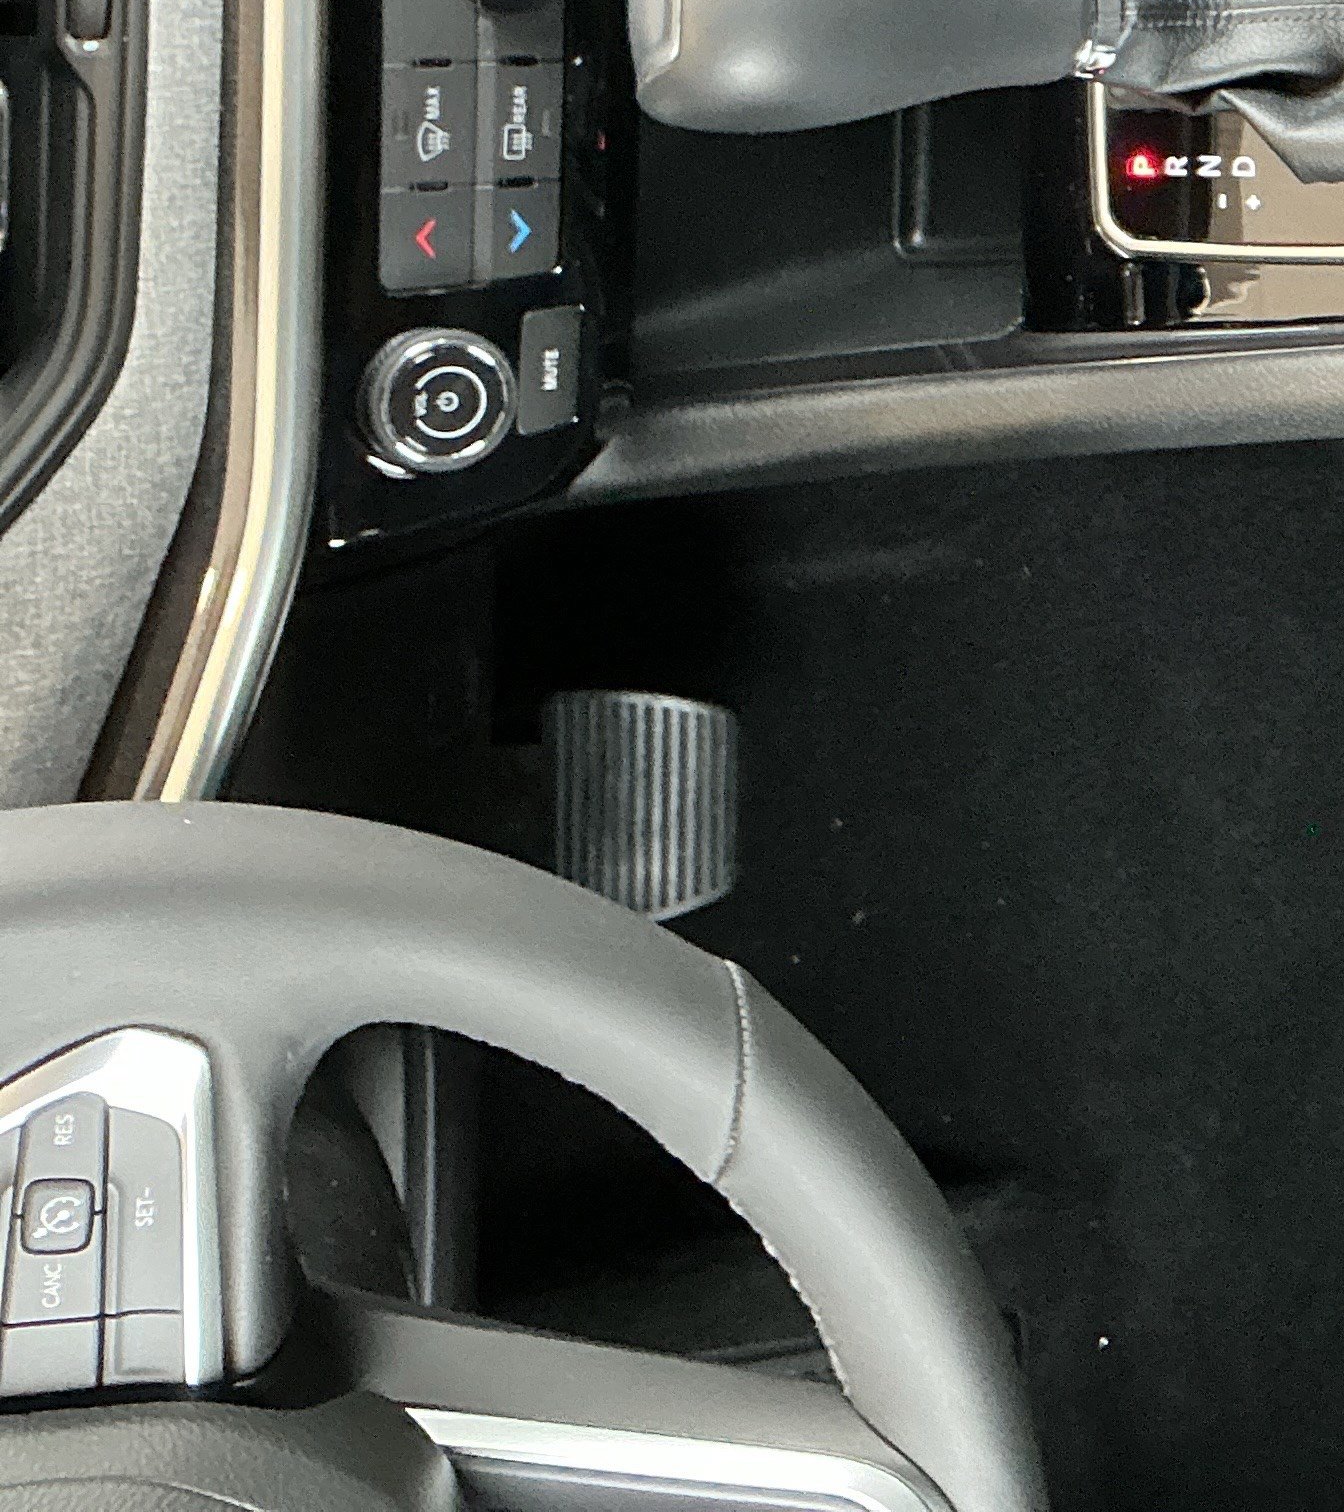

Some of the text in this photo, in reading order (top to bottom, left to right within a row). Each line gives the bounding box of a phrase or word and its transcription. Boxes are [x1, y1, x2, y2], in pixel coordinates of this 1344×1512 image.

[424, 85, 441, 121] MAX
[1132, 155, 1256, 177] P R N D
[542, 349, 560, 391] MUTE
[53, 1113, 74, 1147] RES
[41, 1263, 62, 1309] CANC
